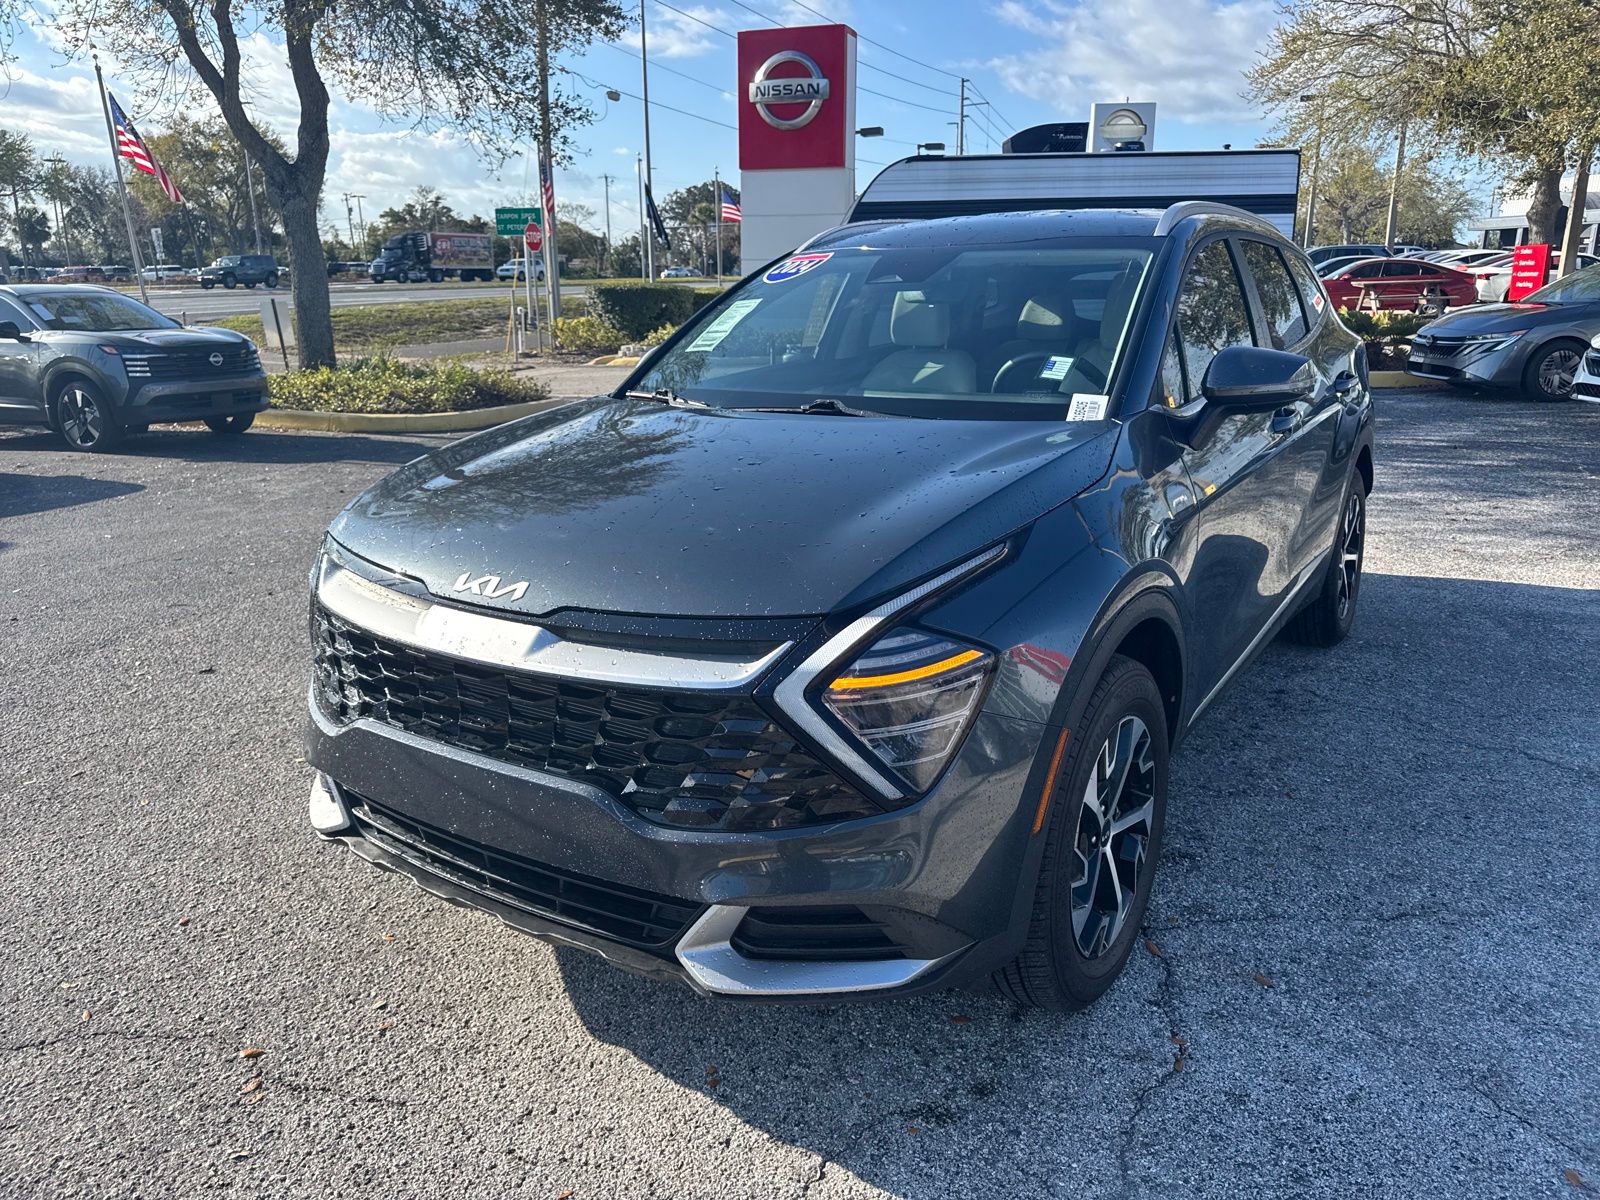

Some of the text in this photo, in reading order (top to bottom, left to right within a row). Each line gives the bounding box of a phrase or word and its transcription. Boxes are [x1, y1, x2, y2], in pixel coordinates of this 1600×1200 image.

[756, 82, 820, 97] NISSAN
[526, 232, 541, 243] STOP
[453, 572, 530, 603] KIA
